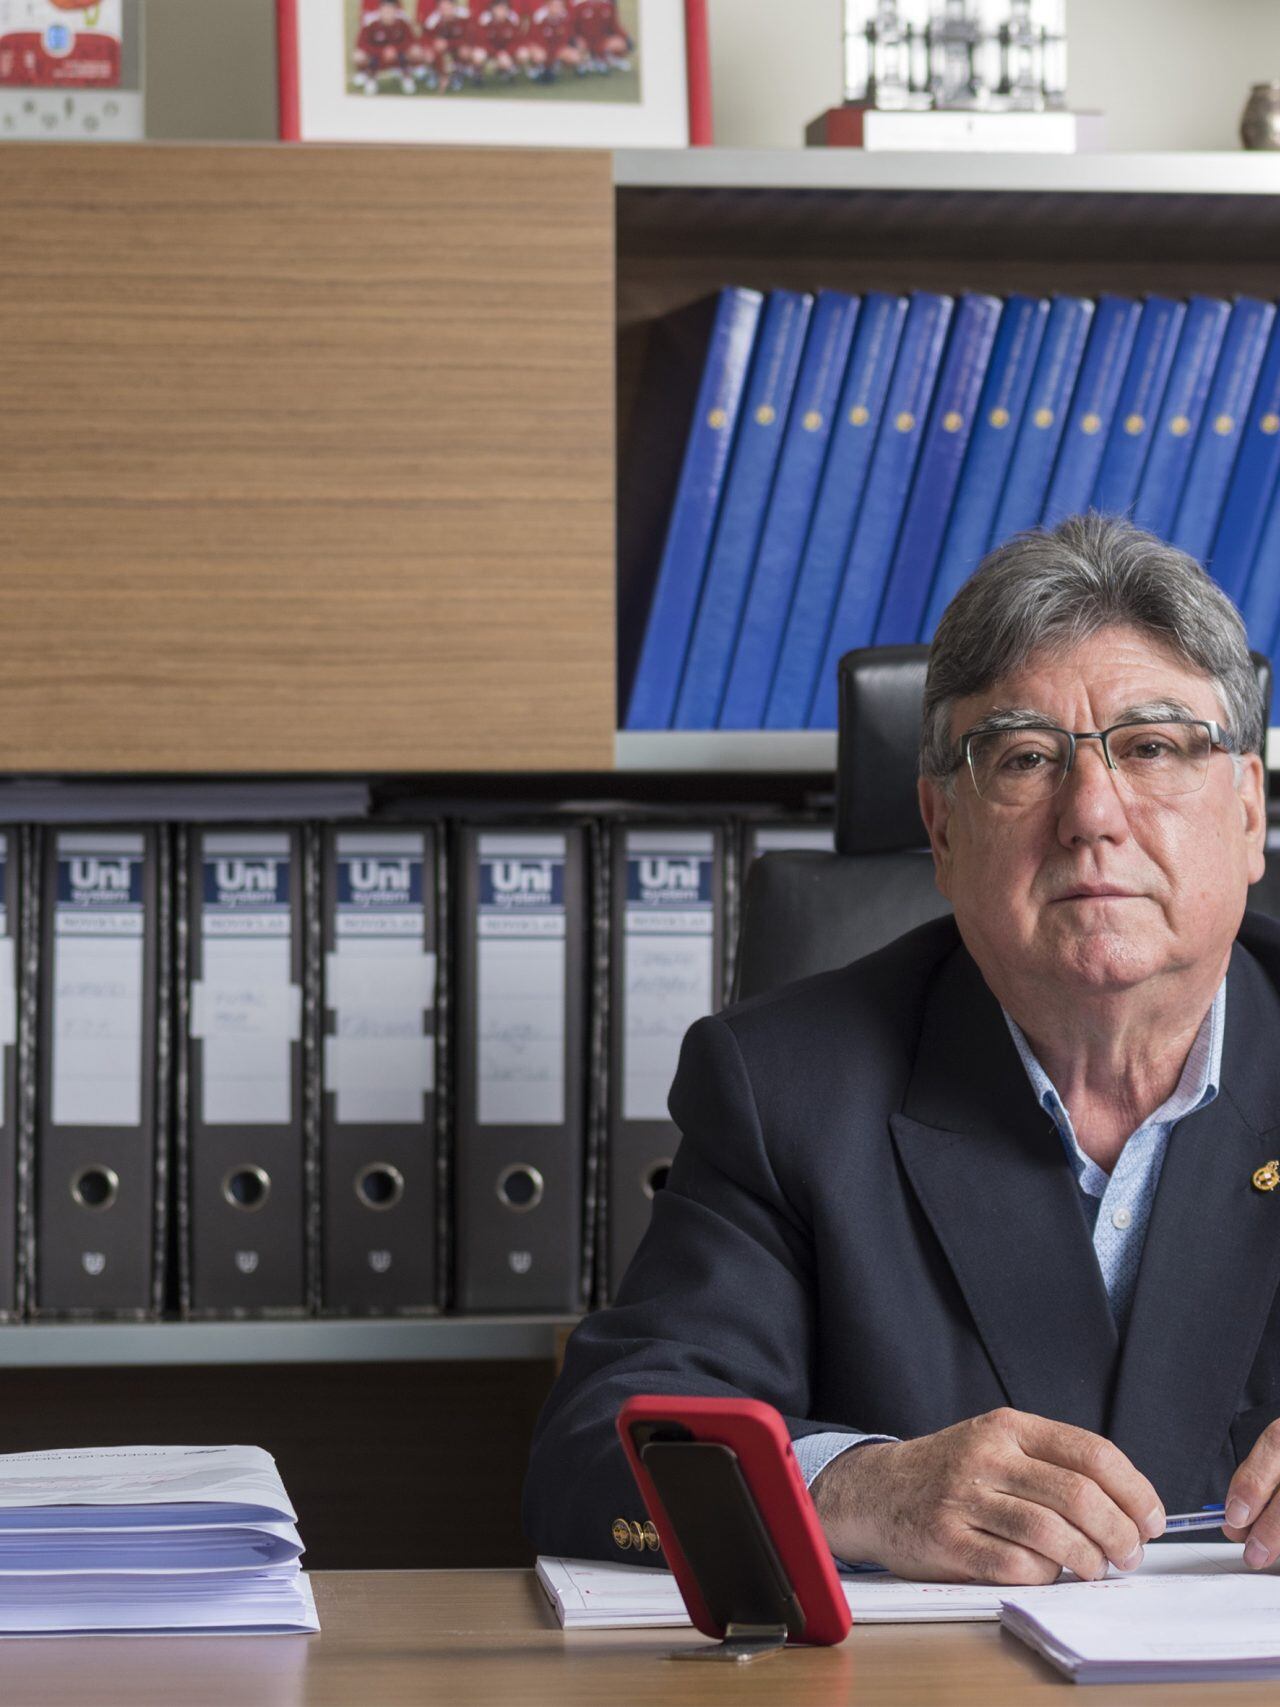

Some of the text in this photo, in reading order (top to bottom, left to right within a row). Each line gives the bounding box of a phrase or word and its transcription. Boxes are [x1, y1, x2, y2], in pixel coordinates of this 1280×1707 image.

[70, 859, 130, 891] Uni
[216, 859, 277, 891] Uni
[349, 859, 410, 891] Uni
[491, 859, 552, 891] Uni
[639, 857, 699, 889] Uni
